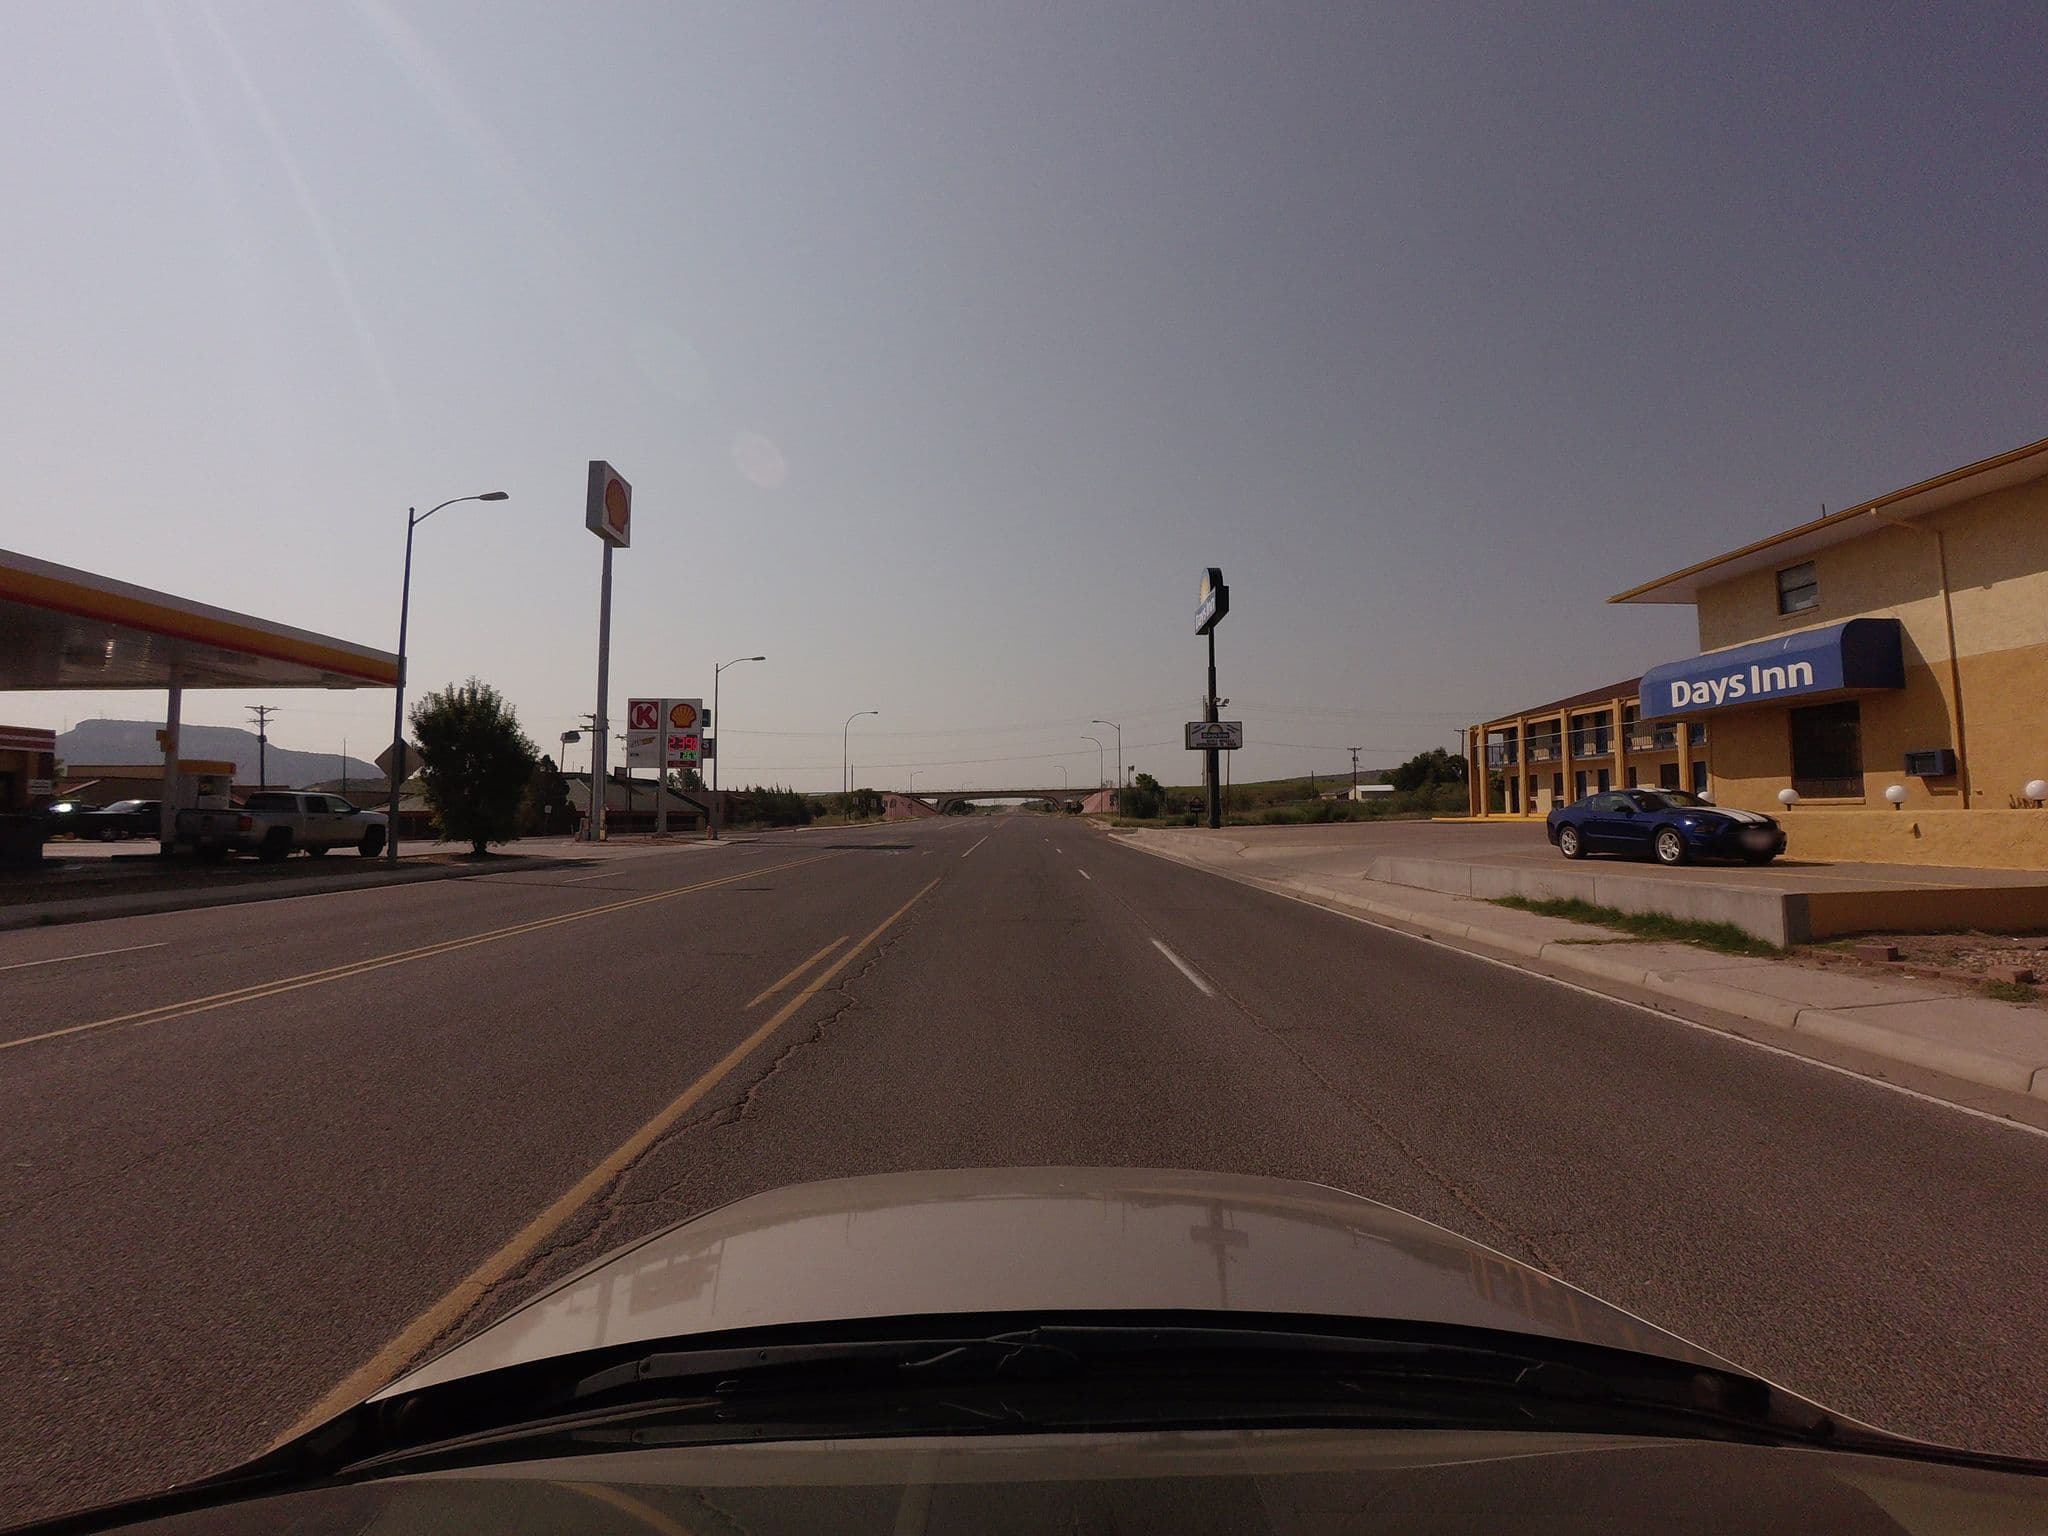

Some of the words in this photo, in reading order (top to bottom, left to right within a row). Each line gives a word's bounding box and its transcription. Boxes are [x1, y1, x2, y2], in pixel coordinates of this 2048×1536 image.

[1671, 674, 1746, 708] Days
[1750, 661, 1814, 694] Inn
[636, 705, 657, 728] K
